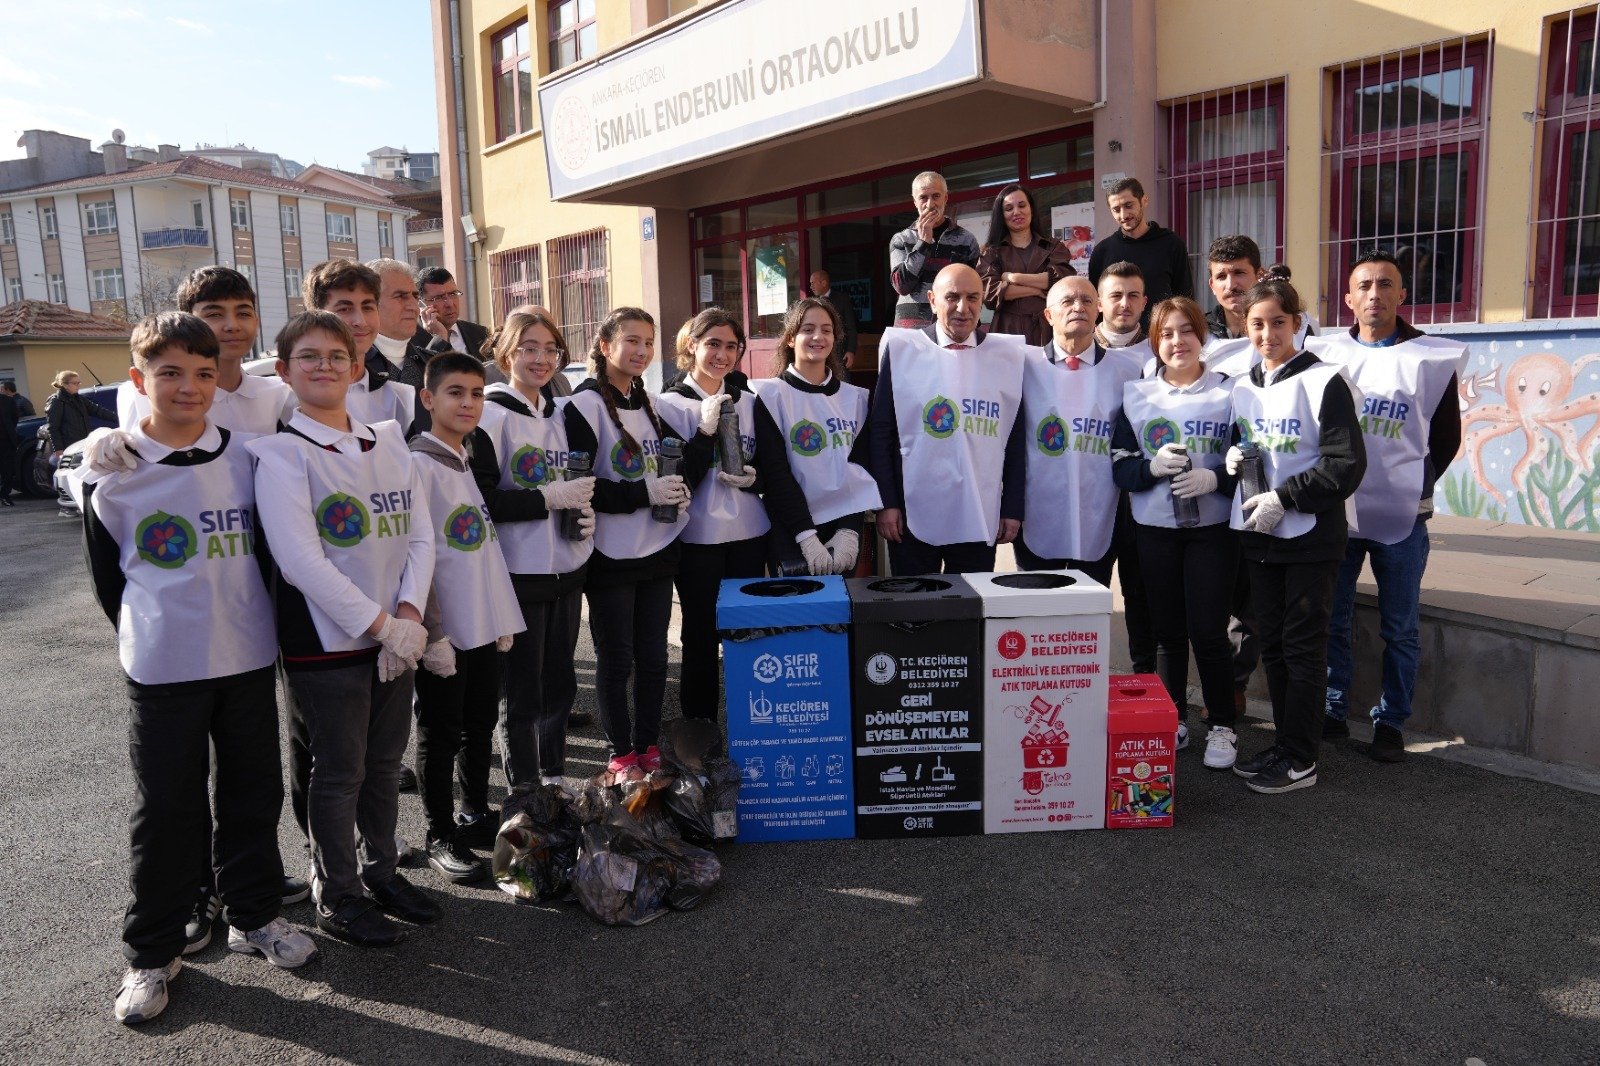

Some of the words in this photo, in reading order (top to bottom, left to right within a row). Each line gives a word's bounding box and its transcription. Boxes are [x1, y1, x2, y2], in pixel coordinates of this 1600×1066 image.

[595, 102, 652, 152] İSMAİL
[654, 58, 756, 133] ENDERUNİ
[760, 6, 920, 96] ORTAOKULU
[963, 398, 1000, 419] SIFIR
[1362, 397, 1410, 421] SIFIR
[963, 415, 1000, 438] ATIK
[1073, 417, 1112, 438] SIFIR
[1184, 420, 1229, 439] SIFIR
[1360, 415, 1405, 440] ATIK
[643, 439, 661, 456] SIF
[1073, 433, 1110, 456] ATIK
[545, 449, 568, 468] SIF
[378, 512, 411, 539] ATI
[1048, 631, 1098, 643] KEÇİÖREN
[1031, 642, 1097, 656] BELEDİYESİ
[784, 653, 819, 666] SIFIR
[917, 654, 968, 667] KEÇİÖREN
[785, 665, 820, 679] ATIK
[900, 666, 968, 680] BELEDİYESİ
[992, 664, 1038, 678] ELEKTRİKLİ
[1039, 666, 1050, 676] VE
[1051, 662, 1100, 675] ELEKTRONİK
[1001, 681, 1020, 692] ATIK
[1021, 680, 1059, 691] TOPLAMA
[1059, 678, 1092, 689] KUTUSU
[775, 700, 829, 713] KEÇİÖREN
[900, 692, 932, 707] GERİ
[776, 711, 829, 724] BELEDİYESİ
[865, 709, 968, 726] DÖNÜŞEMEYEN
[865, 728, 908, 743] EVSEL
[910, 726, 969, 740] ATIKLAR
[1119, 740, 1145, 751] ATIK
[1148, 737, 1166, 749] PİL
